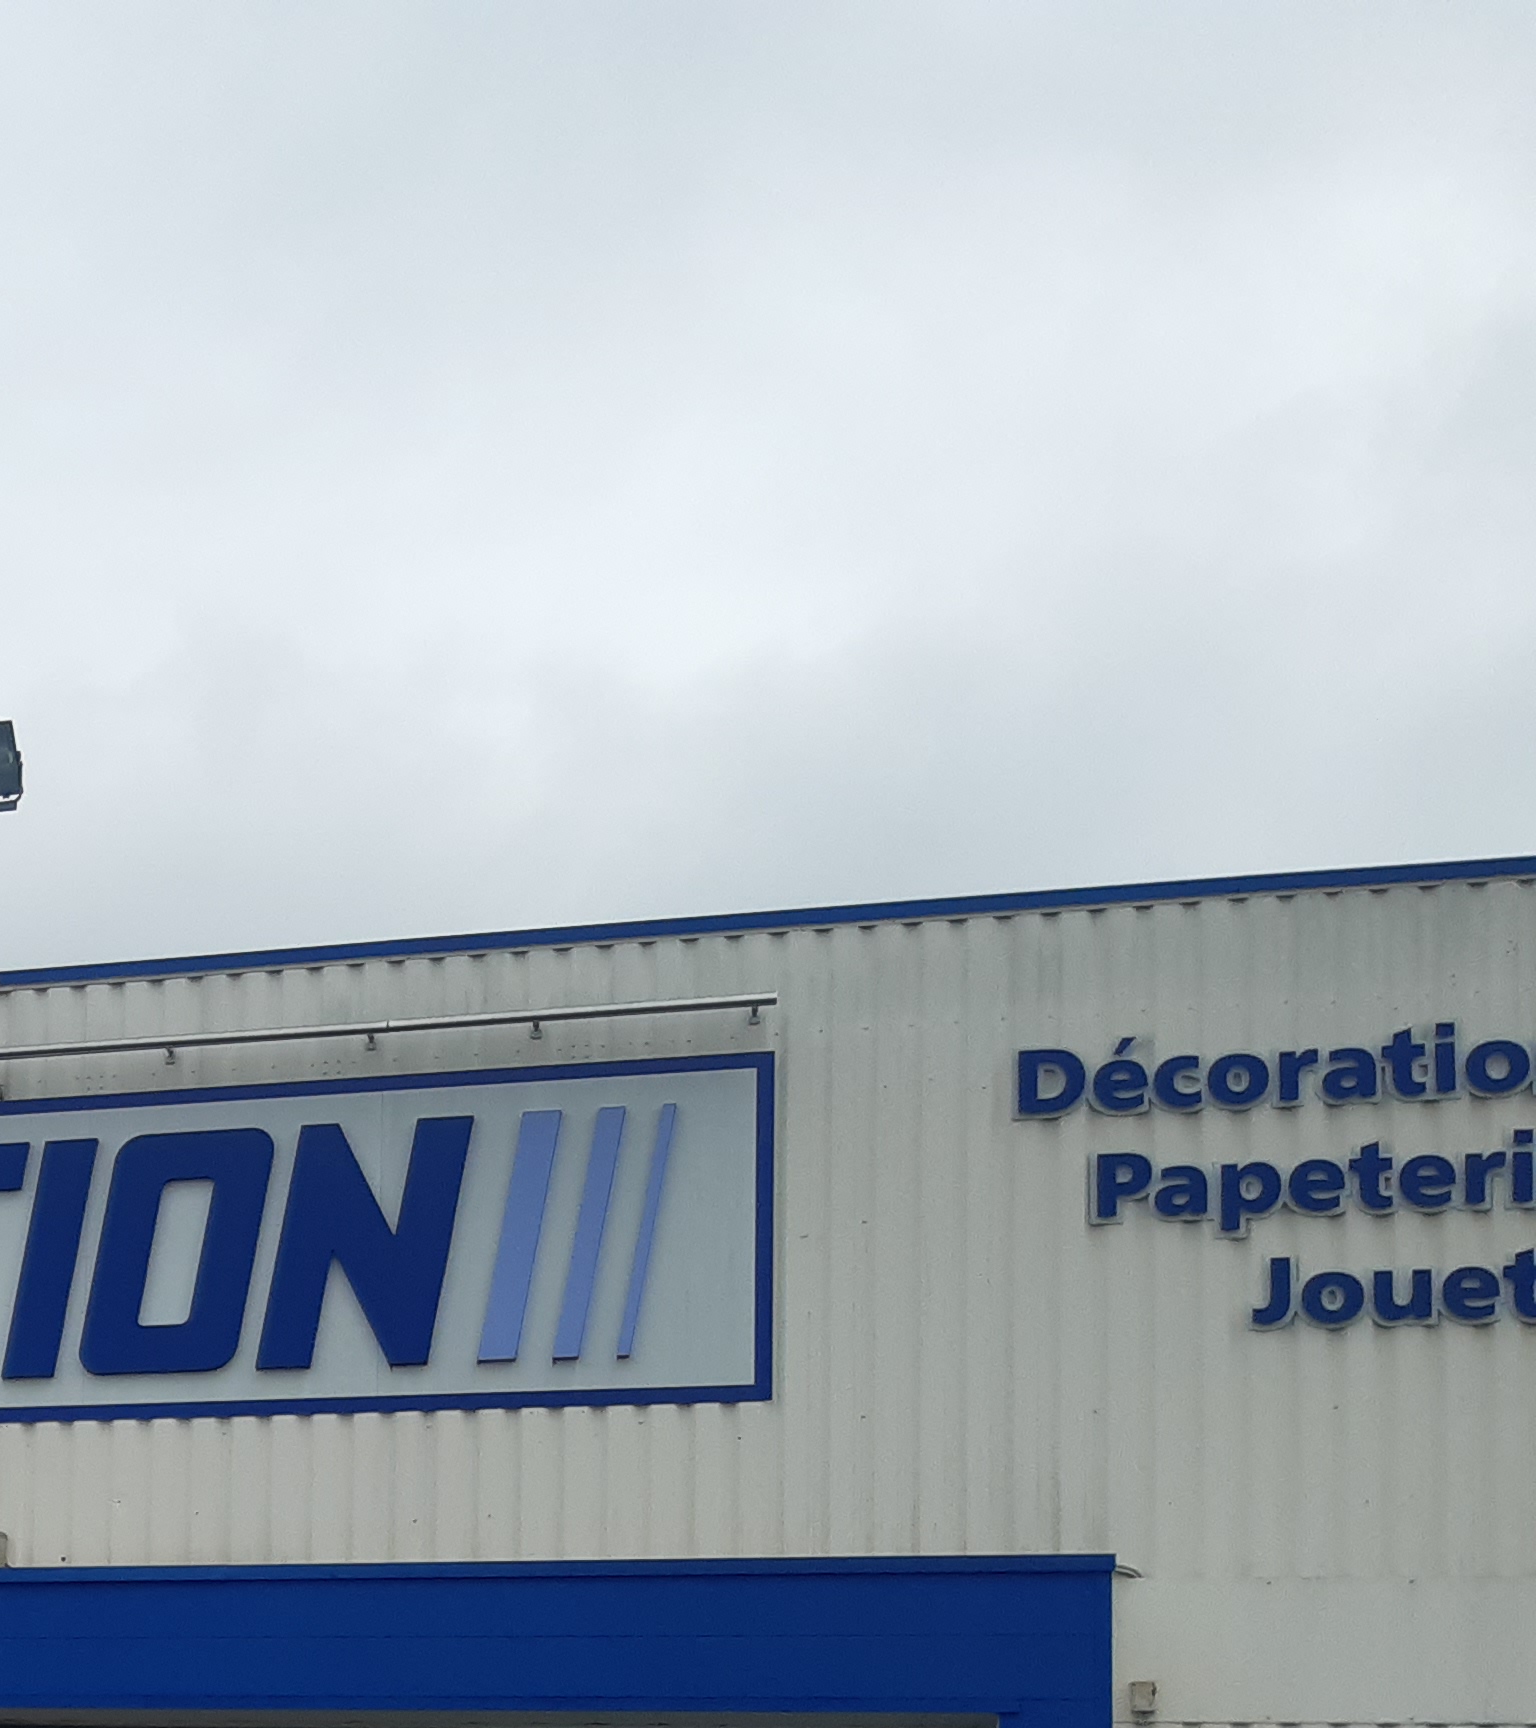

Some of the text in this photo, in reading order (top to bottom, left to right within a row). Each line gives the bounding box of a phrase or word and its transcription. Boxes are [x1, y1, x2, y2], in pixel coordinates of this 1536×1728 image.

[1017, 1022, 1530, 1115] Décoratio
[1096, 1129, 1534, 1231] Papeteri
[1252, 1248, 1536, 1325] Jouet
